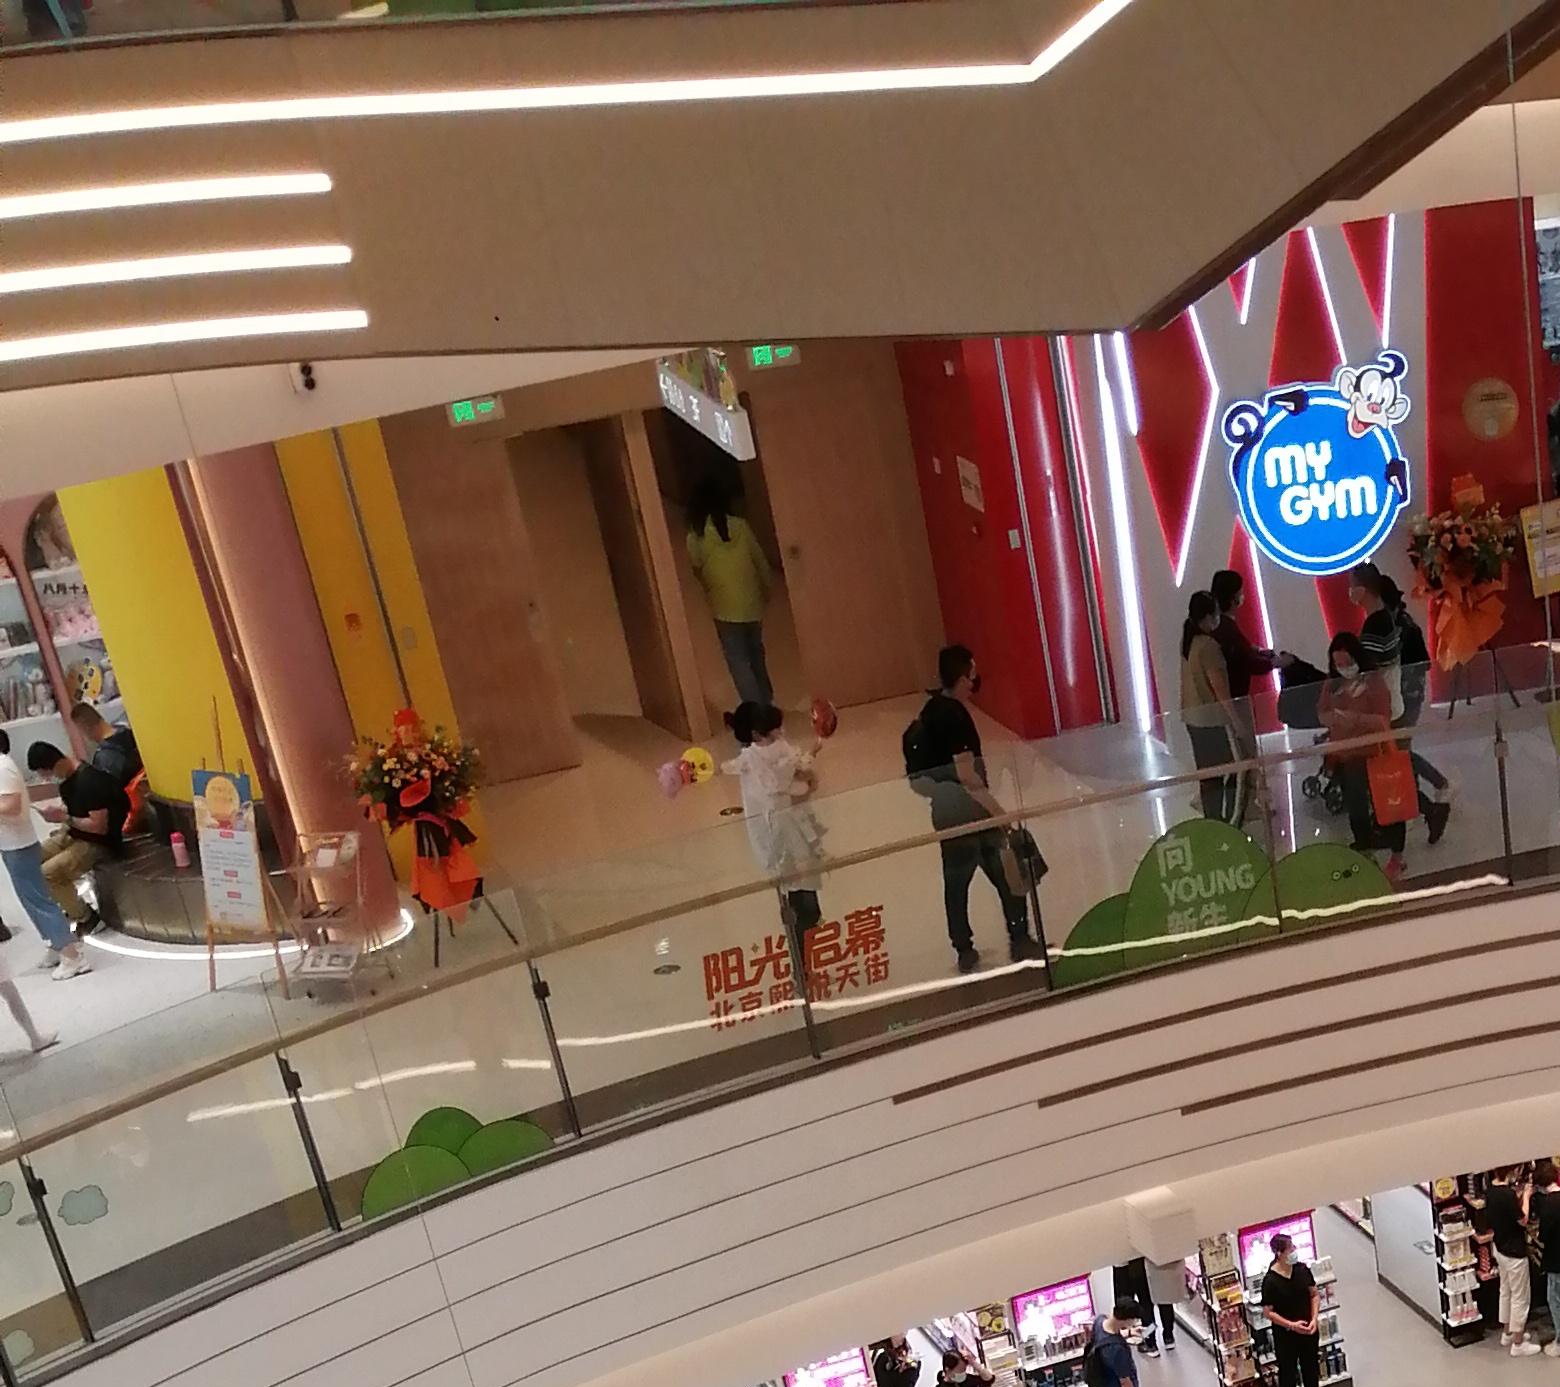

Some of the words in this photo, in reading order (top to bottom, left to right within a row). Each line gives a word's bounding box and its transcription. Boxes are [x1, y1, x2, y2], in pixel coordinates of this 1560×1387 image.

[1264, 440, 1332, 488] MY
[1279, 475, 1378, 526] GYM
[1156, 834, 1193, 878] 向
[1160, 863, 1256, 907] YOUNG
[703, 905, 885, 1001] 阳光启幕
